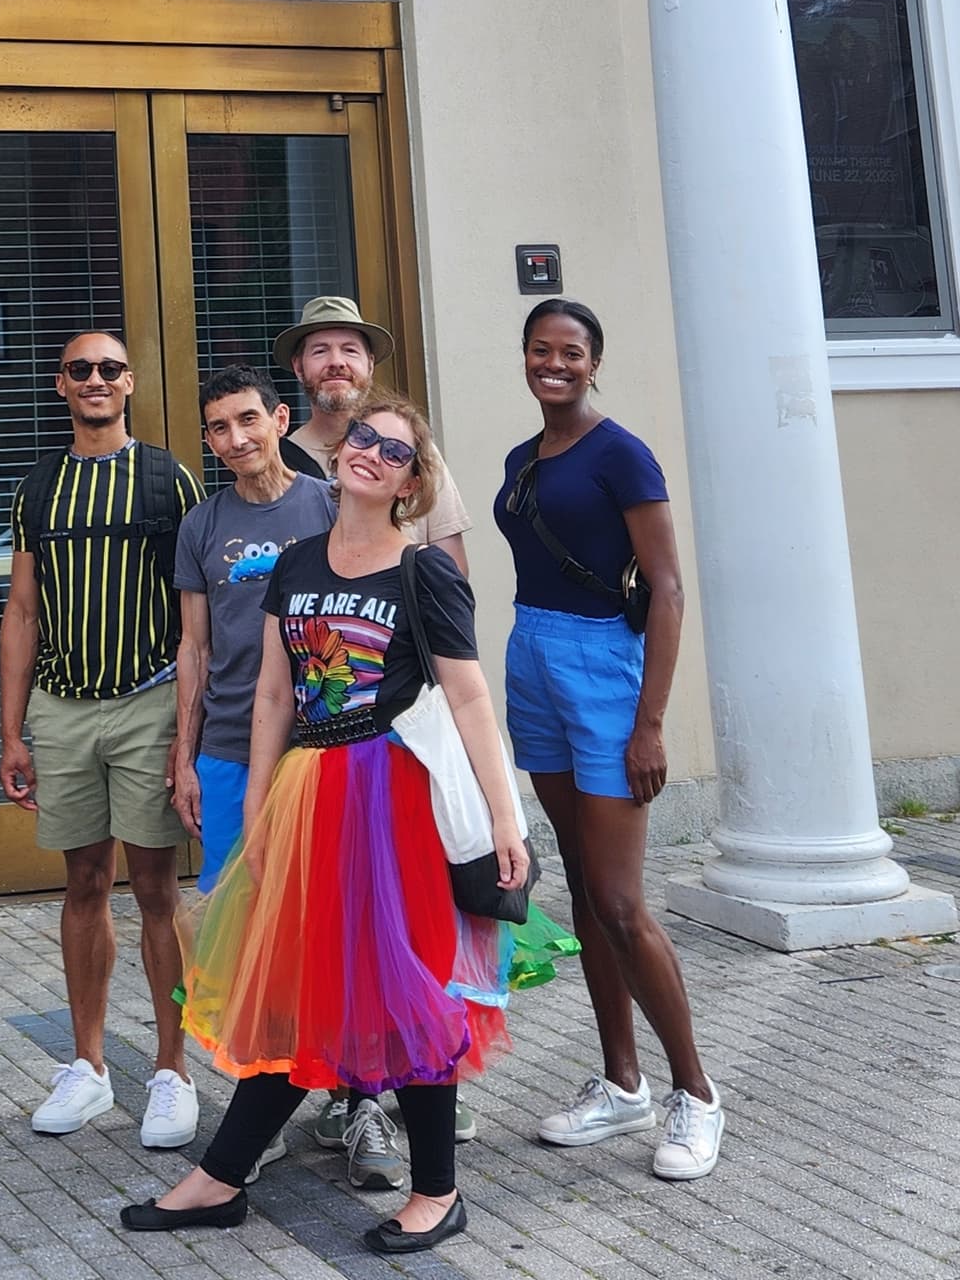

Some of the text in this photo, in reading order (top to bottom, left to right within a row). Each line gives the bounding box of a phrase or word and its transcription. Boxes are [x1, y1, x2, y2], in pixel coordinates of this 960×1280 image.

[288, 592, 397, 629] WE ARE ALL
